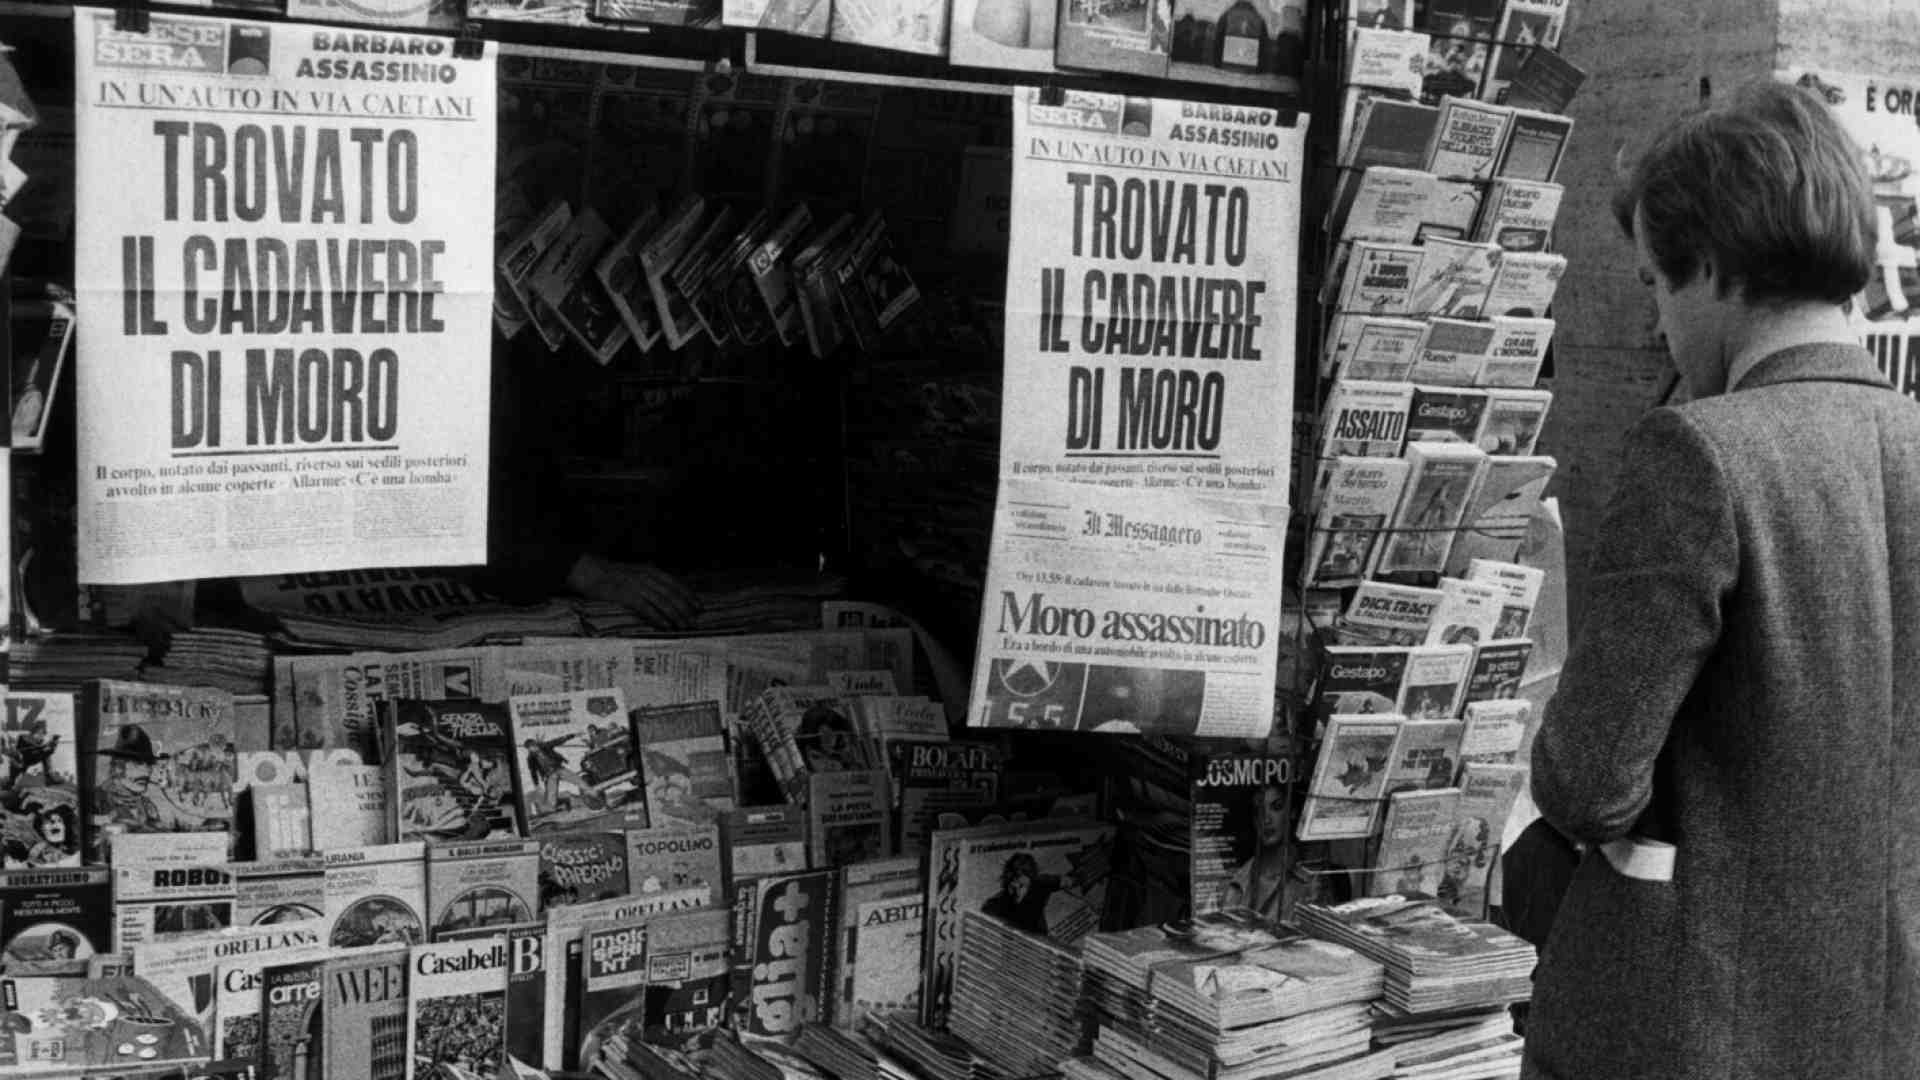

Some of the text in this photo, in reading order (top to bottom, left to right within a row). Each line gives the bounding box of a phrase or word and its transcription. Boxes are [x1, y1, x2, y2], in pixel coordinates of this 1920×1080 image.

[98, 42, 206, 69] SERA
[312, 32, 444, 56] BARBARO
[296, 58, 457, 84] ASSASSINIO
[100, 82, 473, 117] IN UN'AUTO IN VIA CAETANI
[1885, 88, 1920, 117] OR
[1030, 107, 1107, 129] SERA
[1181, 102, 1271, 126] BARBARO
[1169, 124, 1279, 150] ASSASSINIO
[1031, 137, 1051, 155] IN
[1151, 148, 1171, 166] IN
[1179, 152, 1208, 171] VIA
[1214, 155, 1289, 178] CAETANI
[153, 120, 419, 225] TROVATO
[1067, 172, 1249, 267] TROVATO
[122, 234, 446, 336] IL CADAVERE
[1039, 268, 1070, 353] IL
[1081, 269, 1266, 361] CADAVERE
[170, 347, 399, 448] DI MORO
[1066, 366, 1225, 450] DI MORO
[1334, 408, 1405, 441] ASSALTO
[96, 452, 468, 482] Il corpo, notato dai passanti, riverso sui sedili posteriori
[106, 482, 157, 498] avvolto
[159, 481, 175, 495] in
[178, 478, 222, 494] alcune
[225, 478, 275, 496] coperte
[290, 473, 346, 489] Allarme:
[381, 474, 406, 486] una
[1082, 510, 1101, 536] Il
[1105, 513, 1202, 547] Messaggero
[1359, 595, 1393, 612] DICK
[999, 591, 1265, 649] Moro assassinato
[1330, 665, 1387, 681] Gestapo
[325, 852, 365, 864] URANIA
[635, 838, 713, 855] TOPOLINO
[553, 855, 623, 886] PAPERINO
[864, 903, 923, 927] ABIT
[214, 931, 319, 958] ORELLANA
[601, 957, 631, 974] NT
[269, 980, 321, 1006] arre
